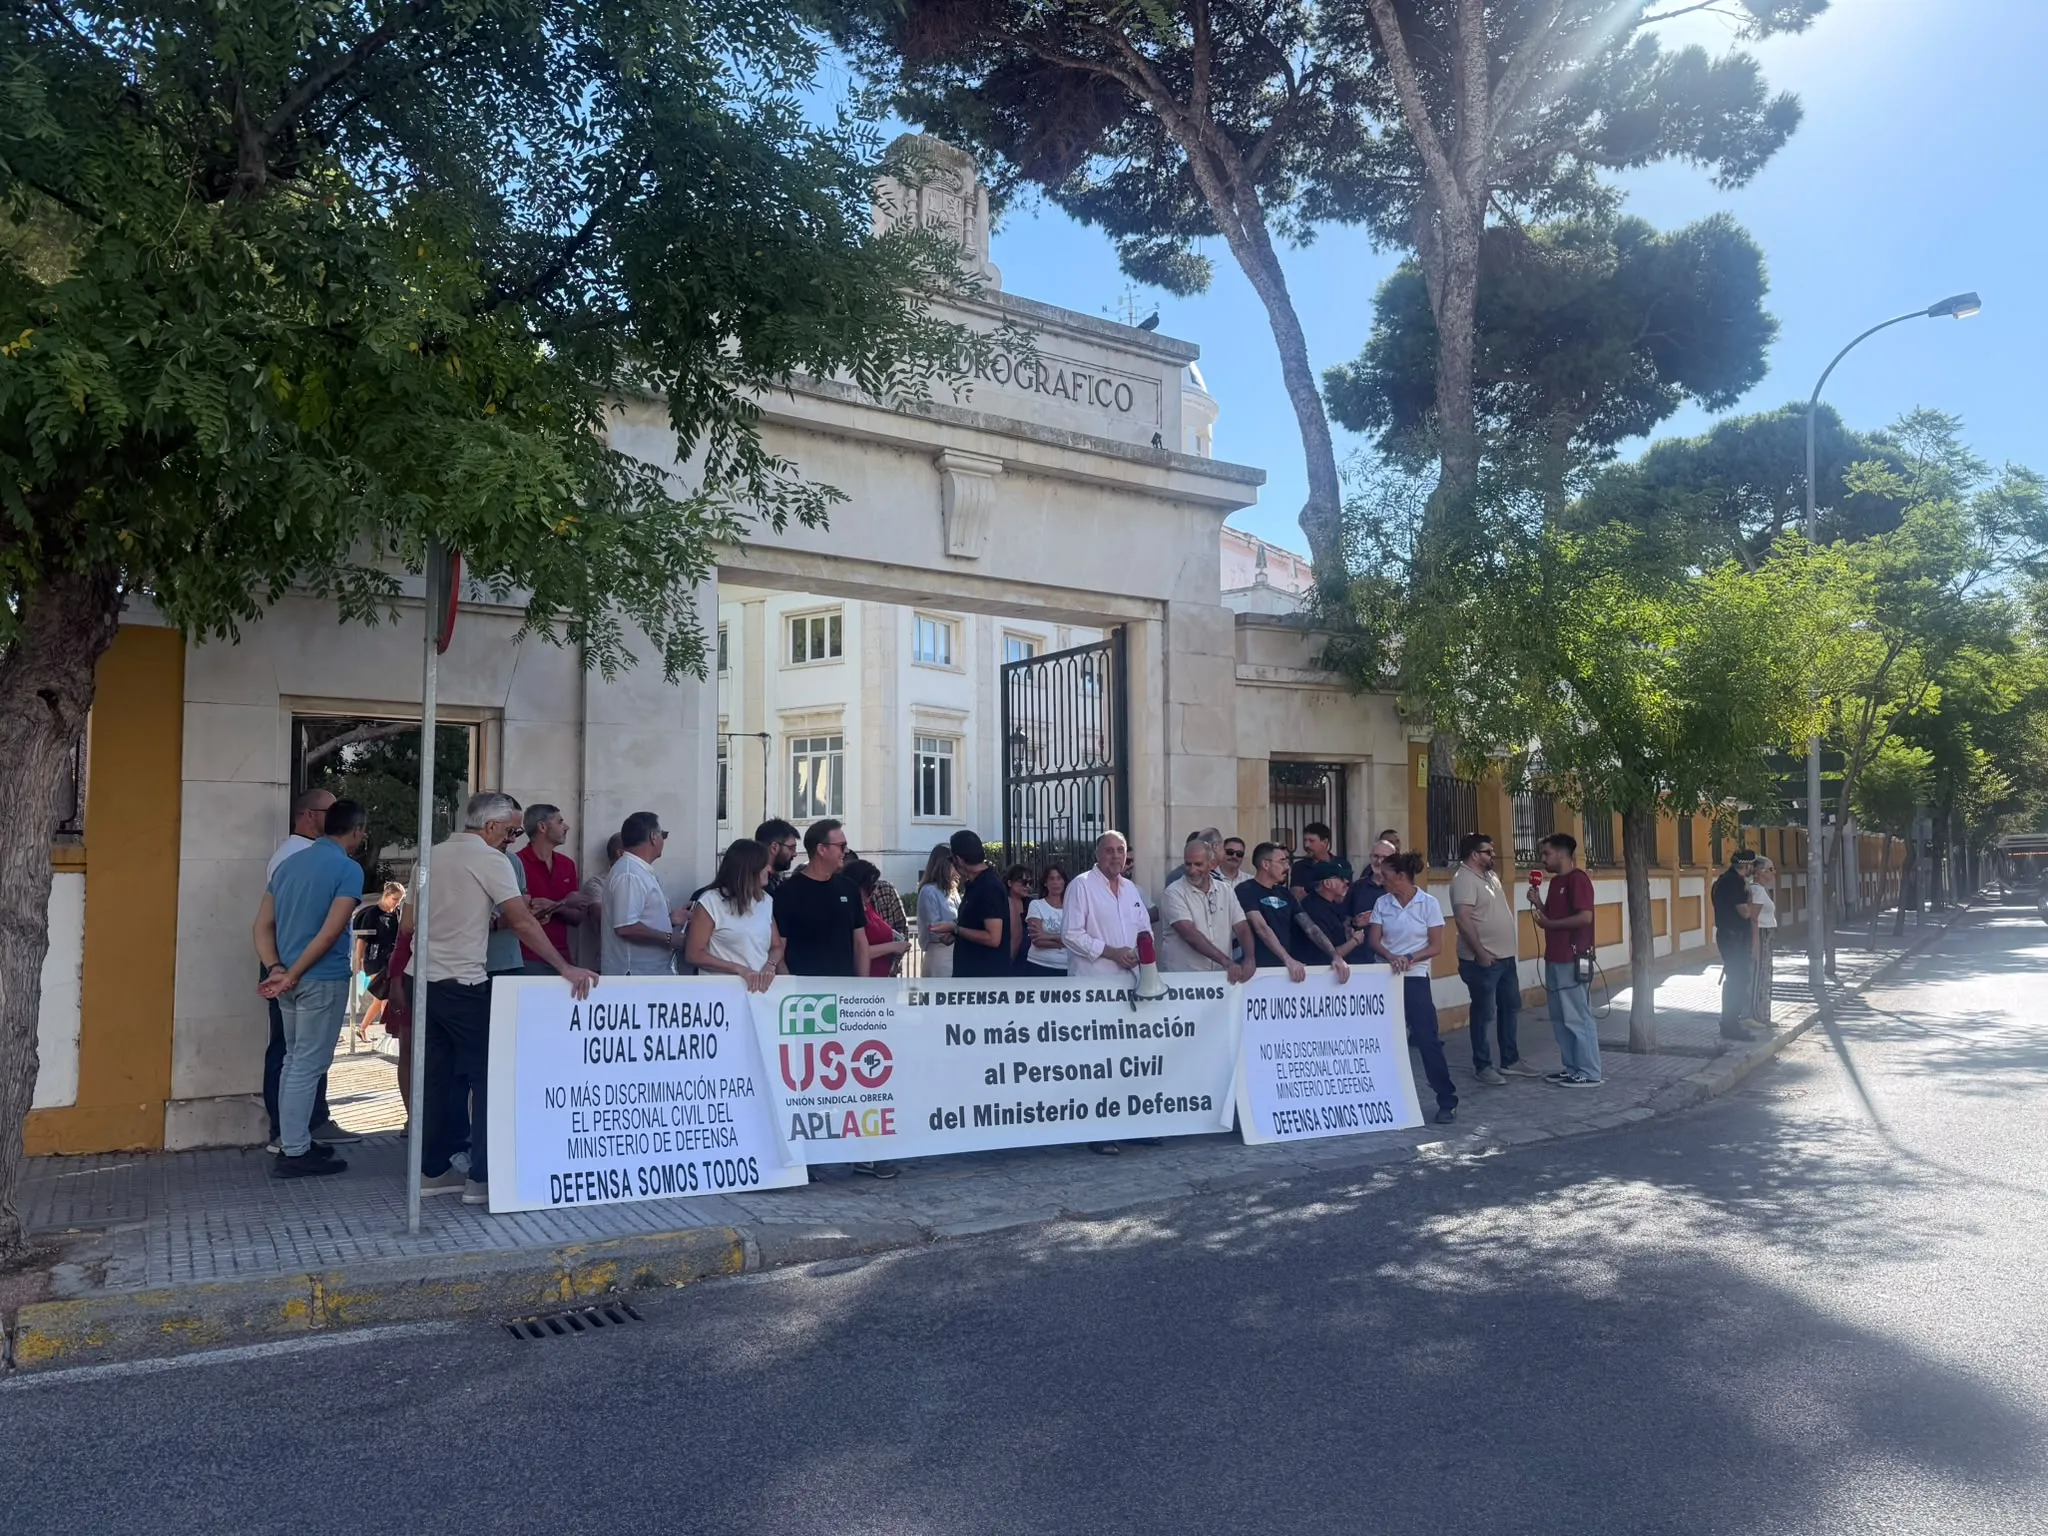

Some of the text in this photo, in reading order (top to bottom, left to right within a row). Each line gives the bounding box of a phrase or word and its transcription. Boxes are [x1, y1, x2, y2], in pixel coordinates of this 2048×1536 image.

[839, 994, 885, 1005] Federación
[908, 986, 1225, 1006] EN DEFENSA DE UNOS SALAR DIGNOS
[1246, 993, 1385, 1021] POR UNOS SALARIOS DIGNOS
[569, 1001, 730, 1032] A IGUAL TRABAJO,
[839, 1007, 895, 1018] Atención a la
[839, 1020, 888, 1031] Ciudadanía
[945, 1015, 1195, 1046] No más discriminación
[584, 1033, 718, 1064] IGUAL SALARIO
[1260, 1036, 1381, 1060] NO MÁS DISCRIMINACIÓN PARA
[778, 1039, 893, 1092] USO
[984, 1055, 1163, 1085] al Personal Civil
[1276, 1057, 1371, 1080] EL PERSONAL CIVIL DEL
[545, 1074, 755, 1109] NO MÁS DISCRIMINACIÓN PARA
[785, 1092, 894, 1107] UNIÓN SINDICAL OBRERA
[1276, 1076, 1376, 1100] MINISTERIO DE DEFENSA
[572, 1102, 734, 1133] EL PERSONAL CIVIL DEL
[788, 1107, 897, 1141] APLAGE
[929, 1092, 1213, 1131] del Ministerio de Defensa
[1272, 1100, 1394, 1135] DEFENSA SOMOS TODOS
[567, 1126, 739, 1160] MINISTERIO DE DEFENSA
[550, 1156, 760, 1205] DEFENSA SOMOS TODOS
